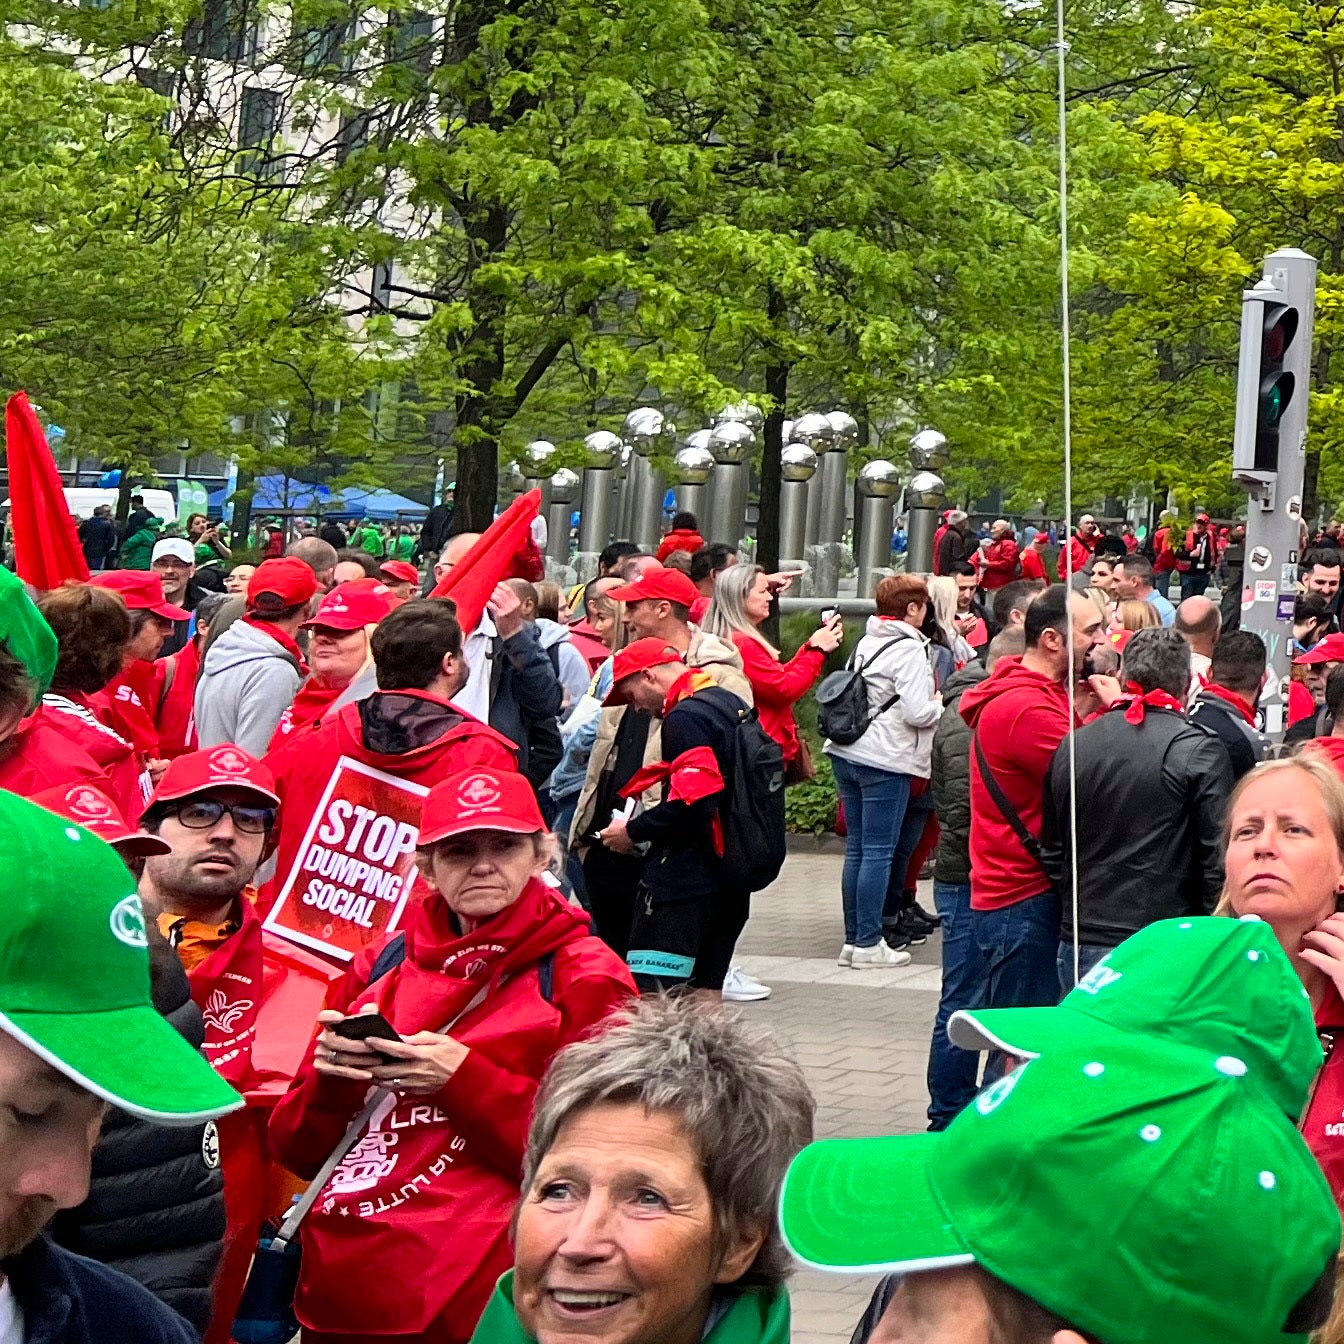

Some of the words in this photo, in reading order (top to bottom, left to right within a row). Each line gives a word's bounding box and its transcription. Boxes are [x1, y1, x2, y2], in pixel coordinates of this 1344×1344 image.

[319, 799, 420, 868] STOP
[303, 844, 403, 903] DUMPING
[302, 878, 377, 929] SOCIAL
[358, 1173, 431, 1217] LUTTE
